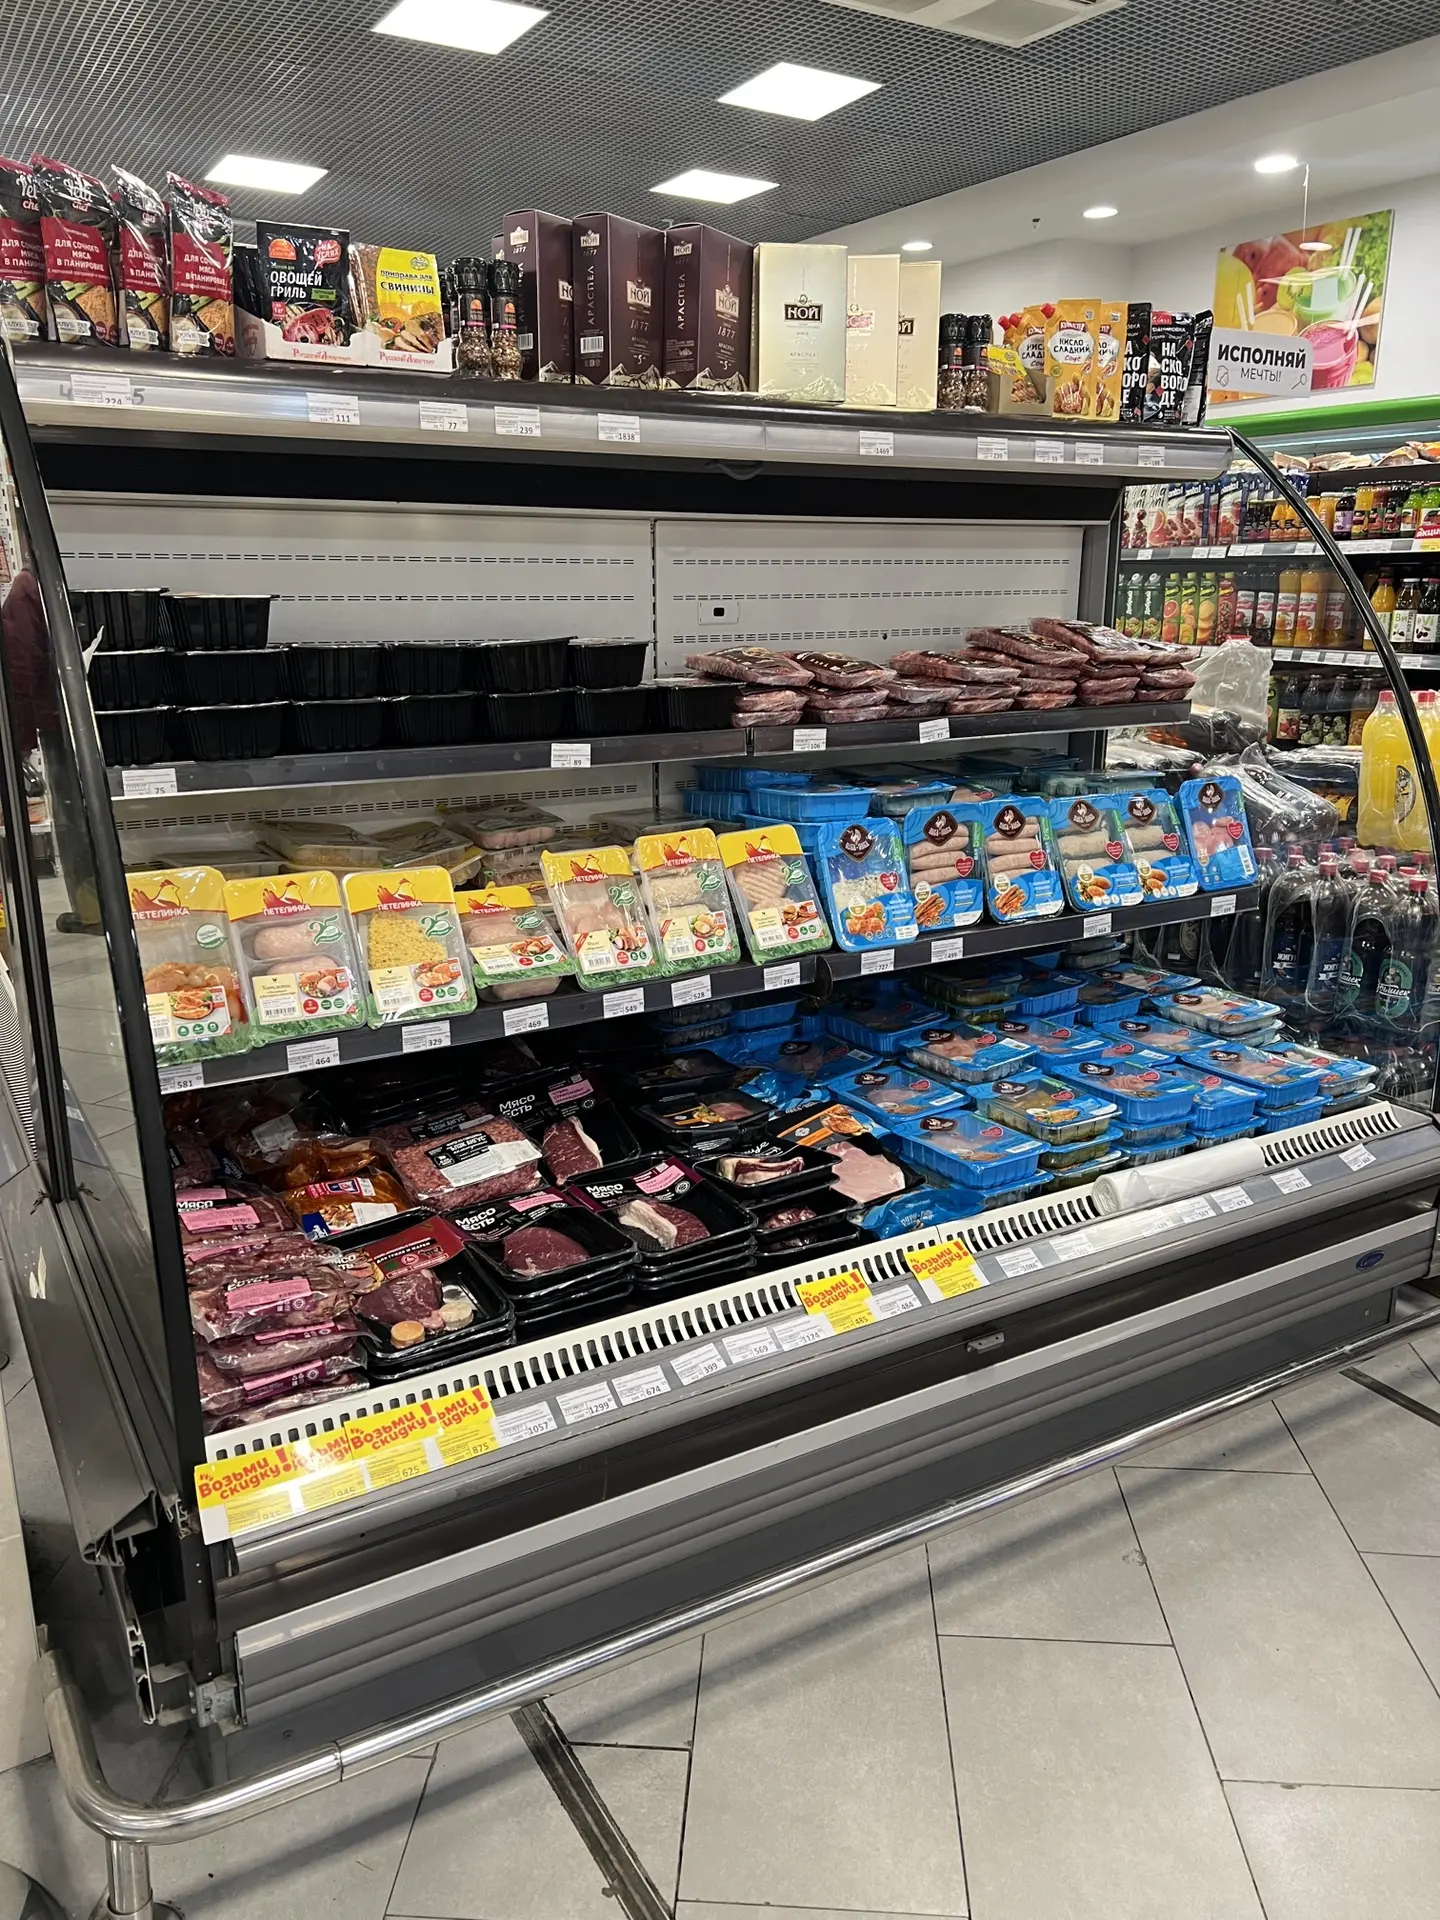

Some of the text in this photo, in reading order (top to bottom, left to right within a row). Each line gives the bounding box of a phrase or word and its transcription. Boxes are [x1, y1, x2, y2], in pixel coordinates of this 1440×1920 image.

[22, 199, 40, 212] che
[54, 238, 71, 248] ДЛЯ
[72, 250, 92, 261] МЯСА
[184, 254, 199, 264] ДЛЯ
[56, 258, 63, 266] В
[270, 270, 322, 288] ОВОЩЕЙ
[270, 285, 307, 299] ГРИЛЬ
[380, 281, 435, 295] СВИНИНЫ
[561, 287, 573, 299] НО
[629, 287, 651, 307] НОЙ
[717, 297, 738, 315] НОЙ
[786, 305, 820, 321] НОЙ
[630, 319, 649, 331] 1877
[717, 325, 736, 339] 1877
[1161, 342, 1176, 356] НА
[1217, 343, 1306, 369] ИСПОЛНЯЙ
[1240, 367, 1282, 383] МЕЧТЫ!
[1160, 392, 1176, 409] ДЕ
[336, 414, 351, 423] 111
[447, 422, 458, 430] 77
[618, 432, 636, 441] 1838
[572, 759, 582, 767] 89
[155, 787, 165, 795] 75
[664, 855, 698, 867] ПЕТЕЛИНКА
[747, 852, 781, 864] ПЕТЕЛИНКА
[572, 873, 610, 883] ПЕТЕЛИНКА
[263, 904, 312, 916] ПЕТЕЛИНКА
[377, 900, 424, 911] ПЕТЕЛИНКА
[470, 906, 512, 915] ПЕТЕЛИНКА
[133, 907, 190, 921] ПЕТЕЛИНКА
[693, 992, 705, 1000] 528
[625, 1004, 638, 1013] 549
[528, 1020, 542, 1028] 469
[428, 1038, 443, 1047] 329
[315, 1056, 331, 1066] 464
[177, 1080, 194, 1090] 581
[911, 1247, 953, 1275] Возьми
[803, 1278, 848, 1308] Возьми
[854, 1316, 869, 1325] 485
[754, 1344, 769, 1355] 569
[703, 1361, 719, 1374] 399
[645, 1385, 662, 1397] 674
[589, 1401, 610, 1415] 1299
[350, 1411, 416, 1450] Возьми
[528, 1421, 550, 1436] 1057
[472, 1442, 490, 1454] 875
[402, 1465, 420, 1478] 625
[198, 1457, 269, 1499] Возьми
